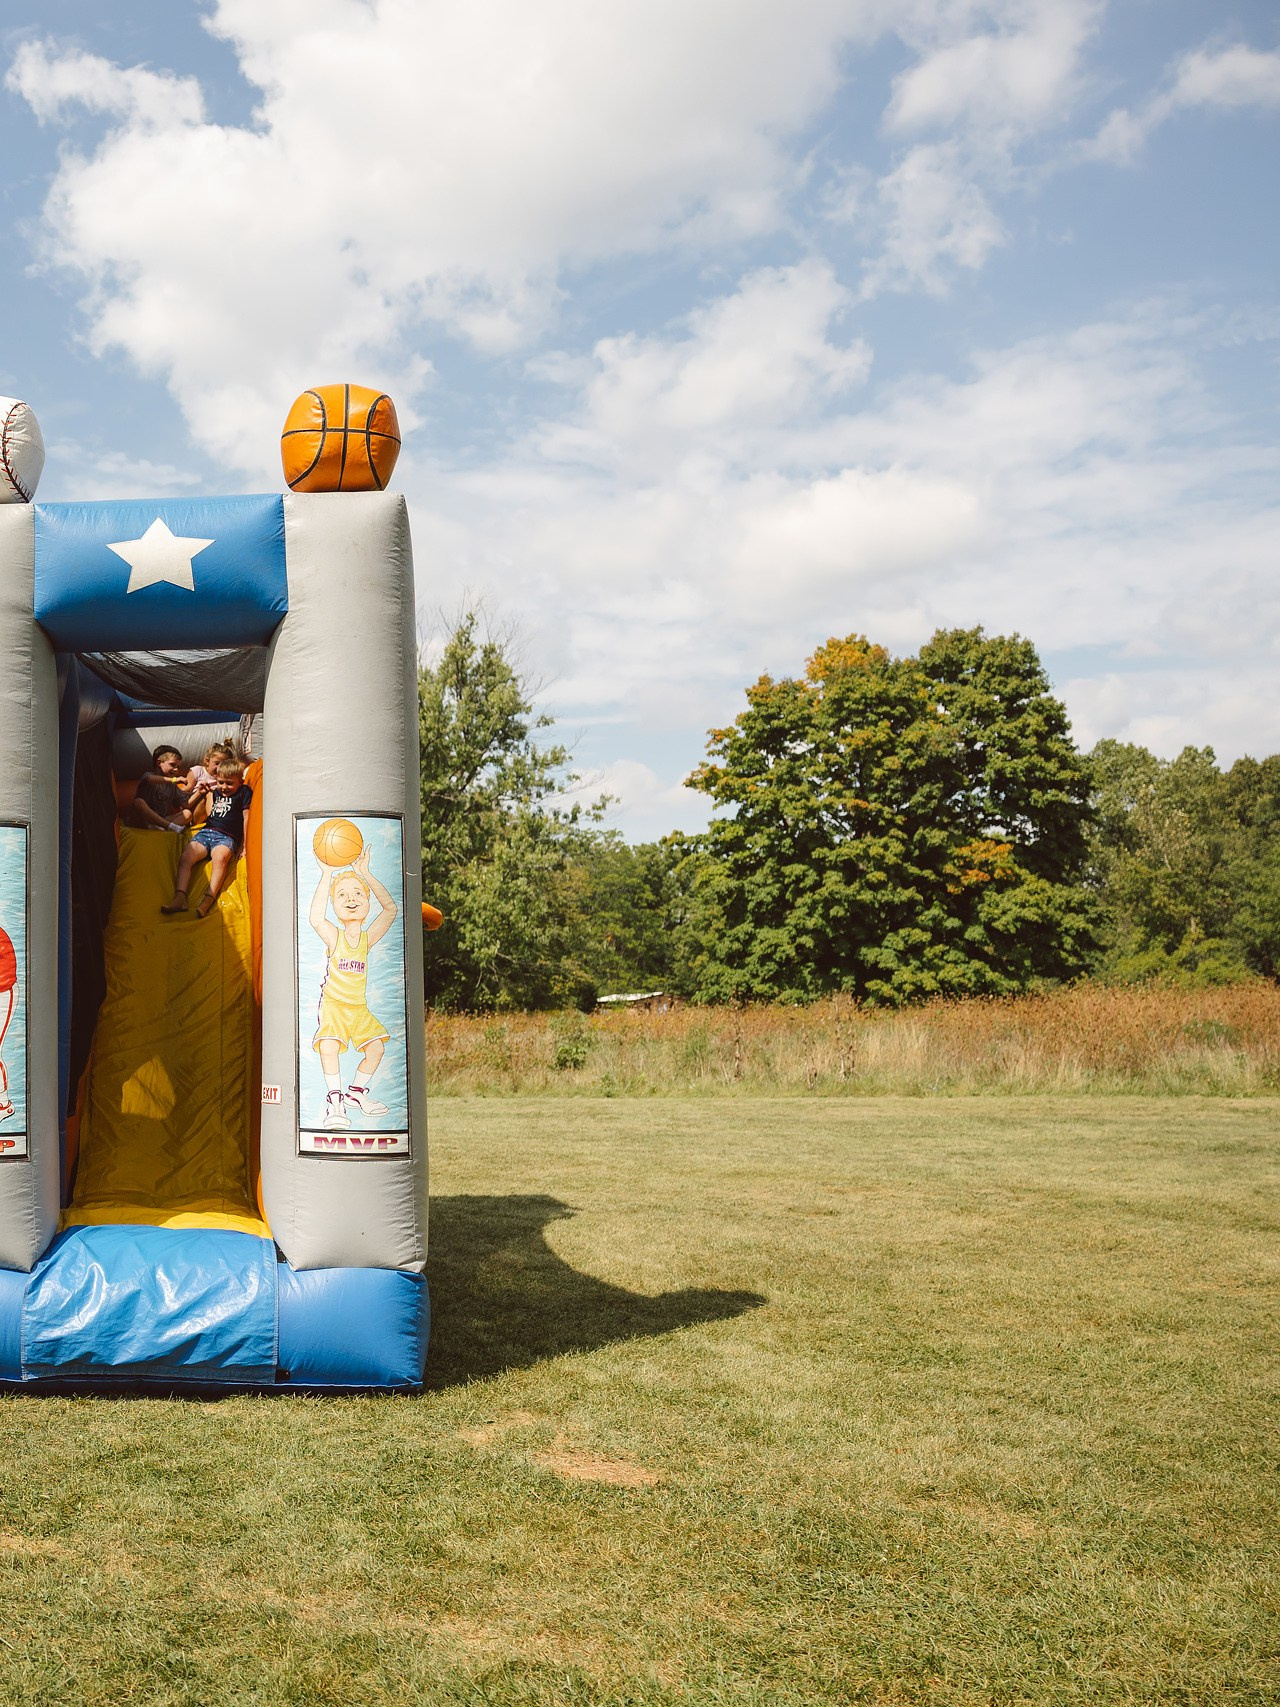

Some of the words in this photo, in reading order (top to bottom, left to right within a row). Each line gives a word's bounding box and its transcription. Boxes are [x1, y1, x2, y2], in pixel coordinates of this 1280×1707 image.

[349, 960, 365, 973] STAR
[263, 1087, 278, 1100] EXIT
[313, 1136, 398, 1150] MVP
